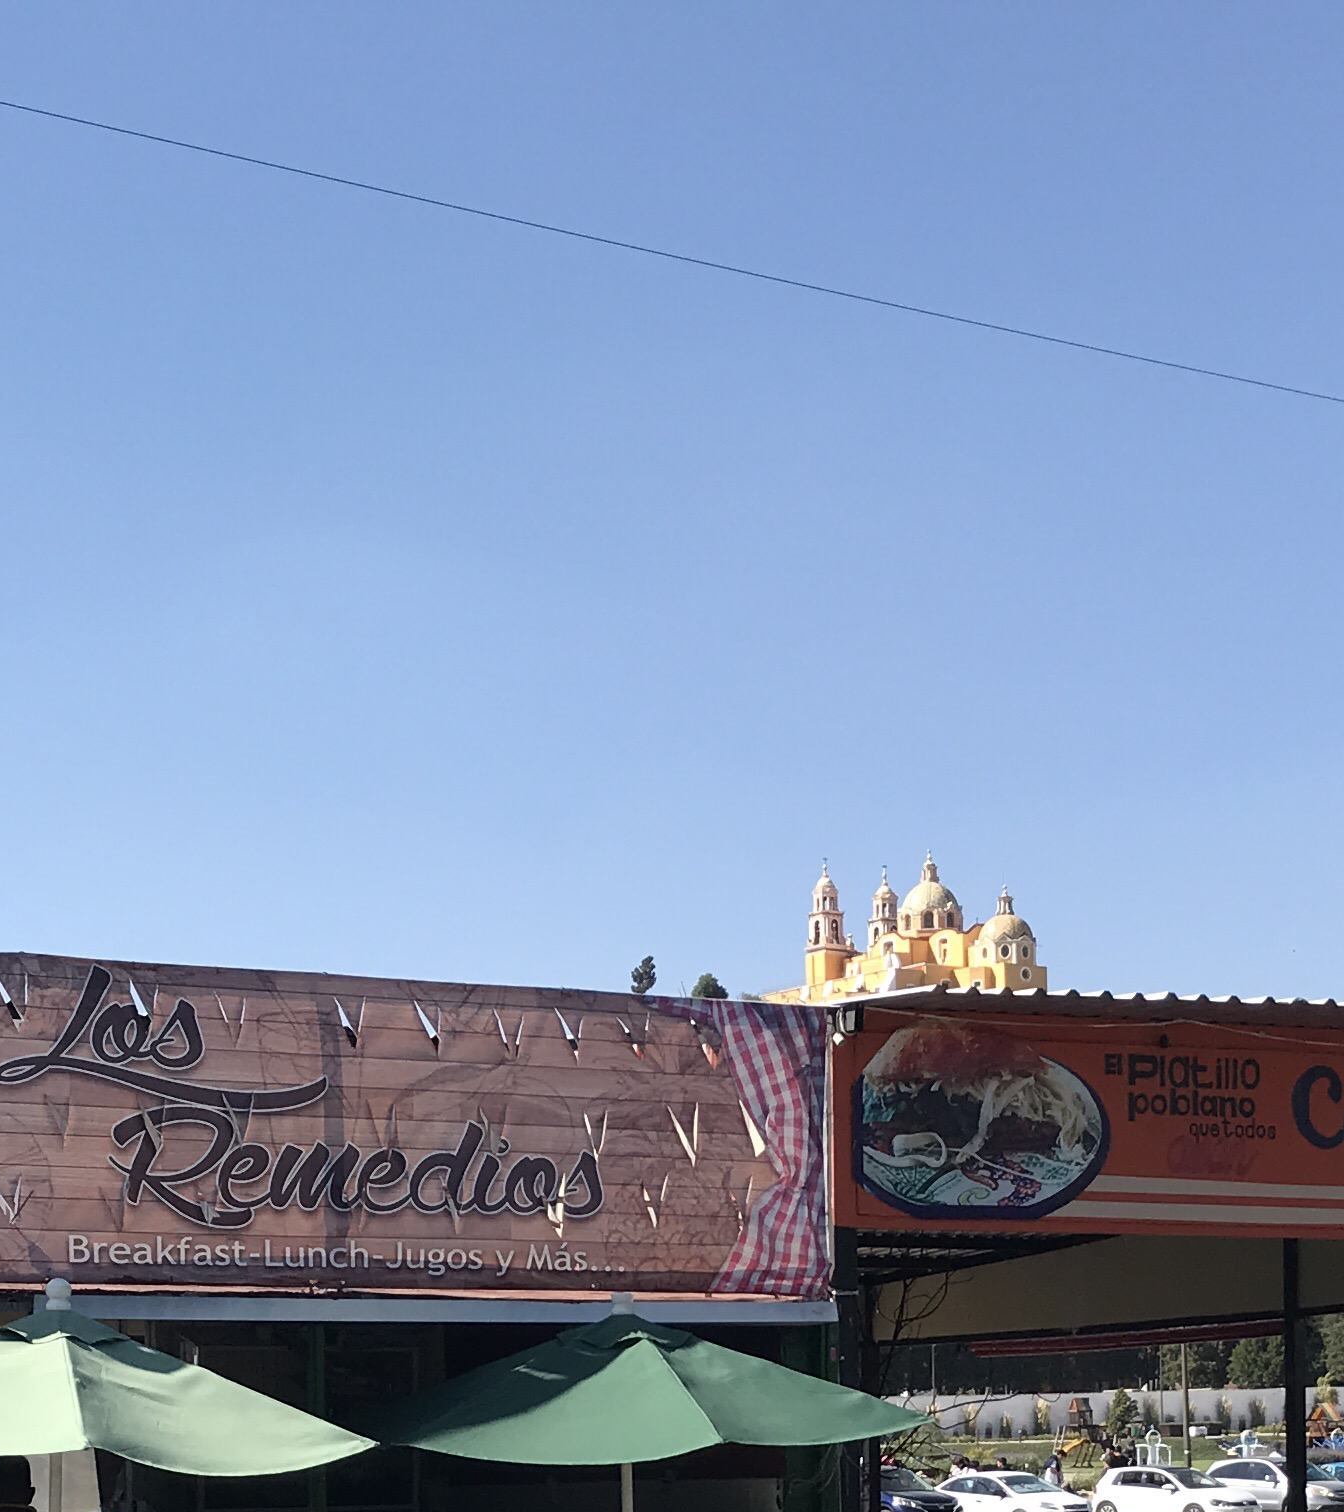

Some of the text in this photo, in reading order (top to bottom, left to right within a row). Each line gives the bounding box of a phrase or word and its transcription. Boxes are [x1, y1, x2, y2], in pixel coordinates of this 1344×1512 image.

[1127, 1089, 1256, 1121] poblano
[108, 1104, 605, 1229] Remedios
[494, 1249, 515, 1276] y
